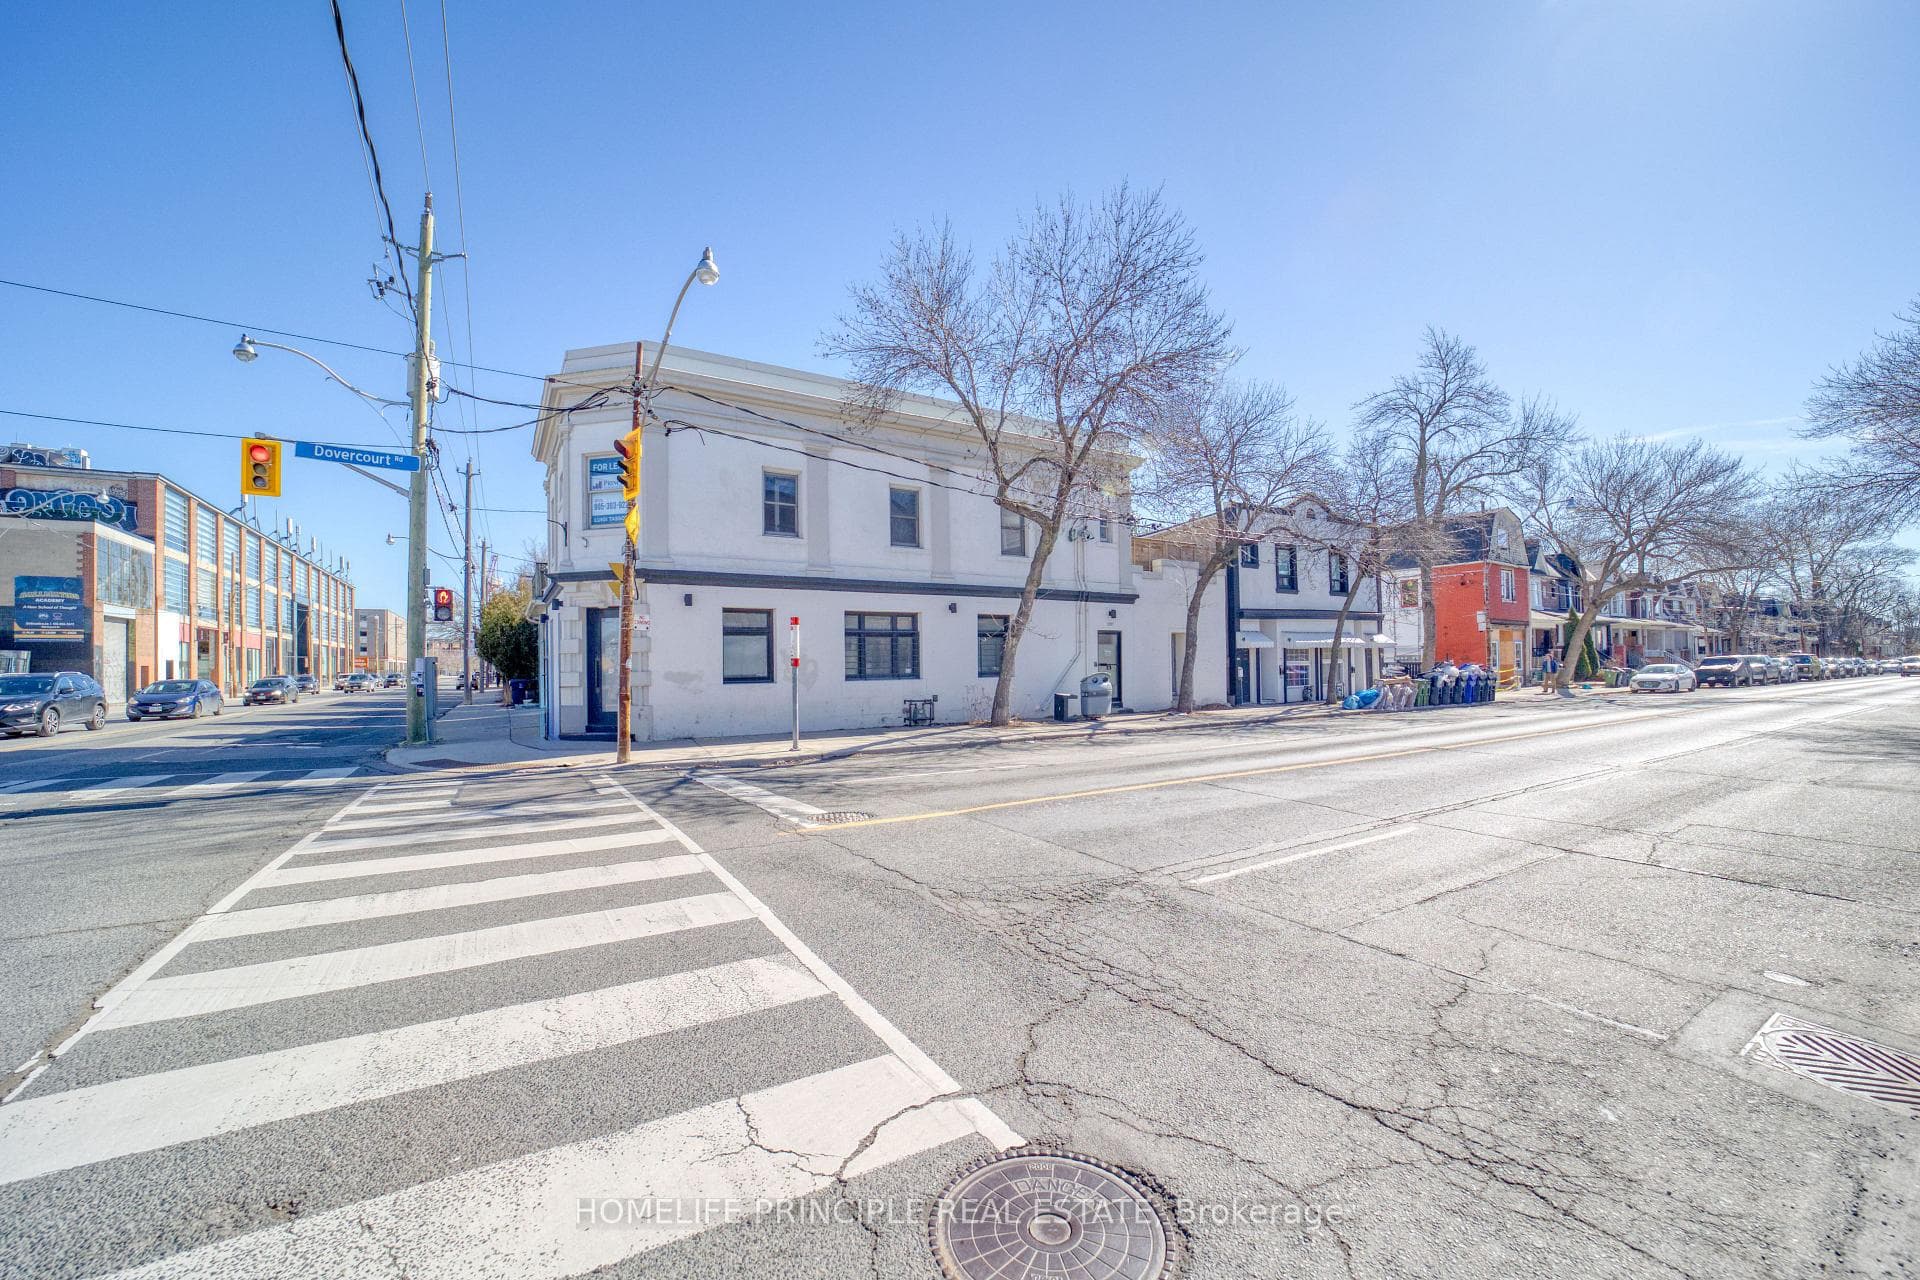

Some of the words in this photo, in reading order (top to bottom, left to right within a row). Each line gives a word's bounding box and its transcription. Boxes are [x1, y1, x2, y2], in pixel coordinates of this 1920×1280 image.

[314, 445, 391, 465] Dovercourt
[394, 455, 404, 463] Rd
[592, 463, 608, 472] FOR
